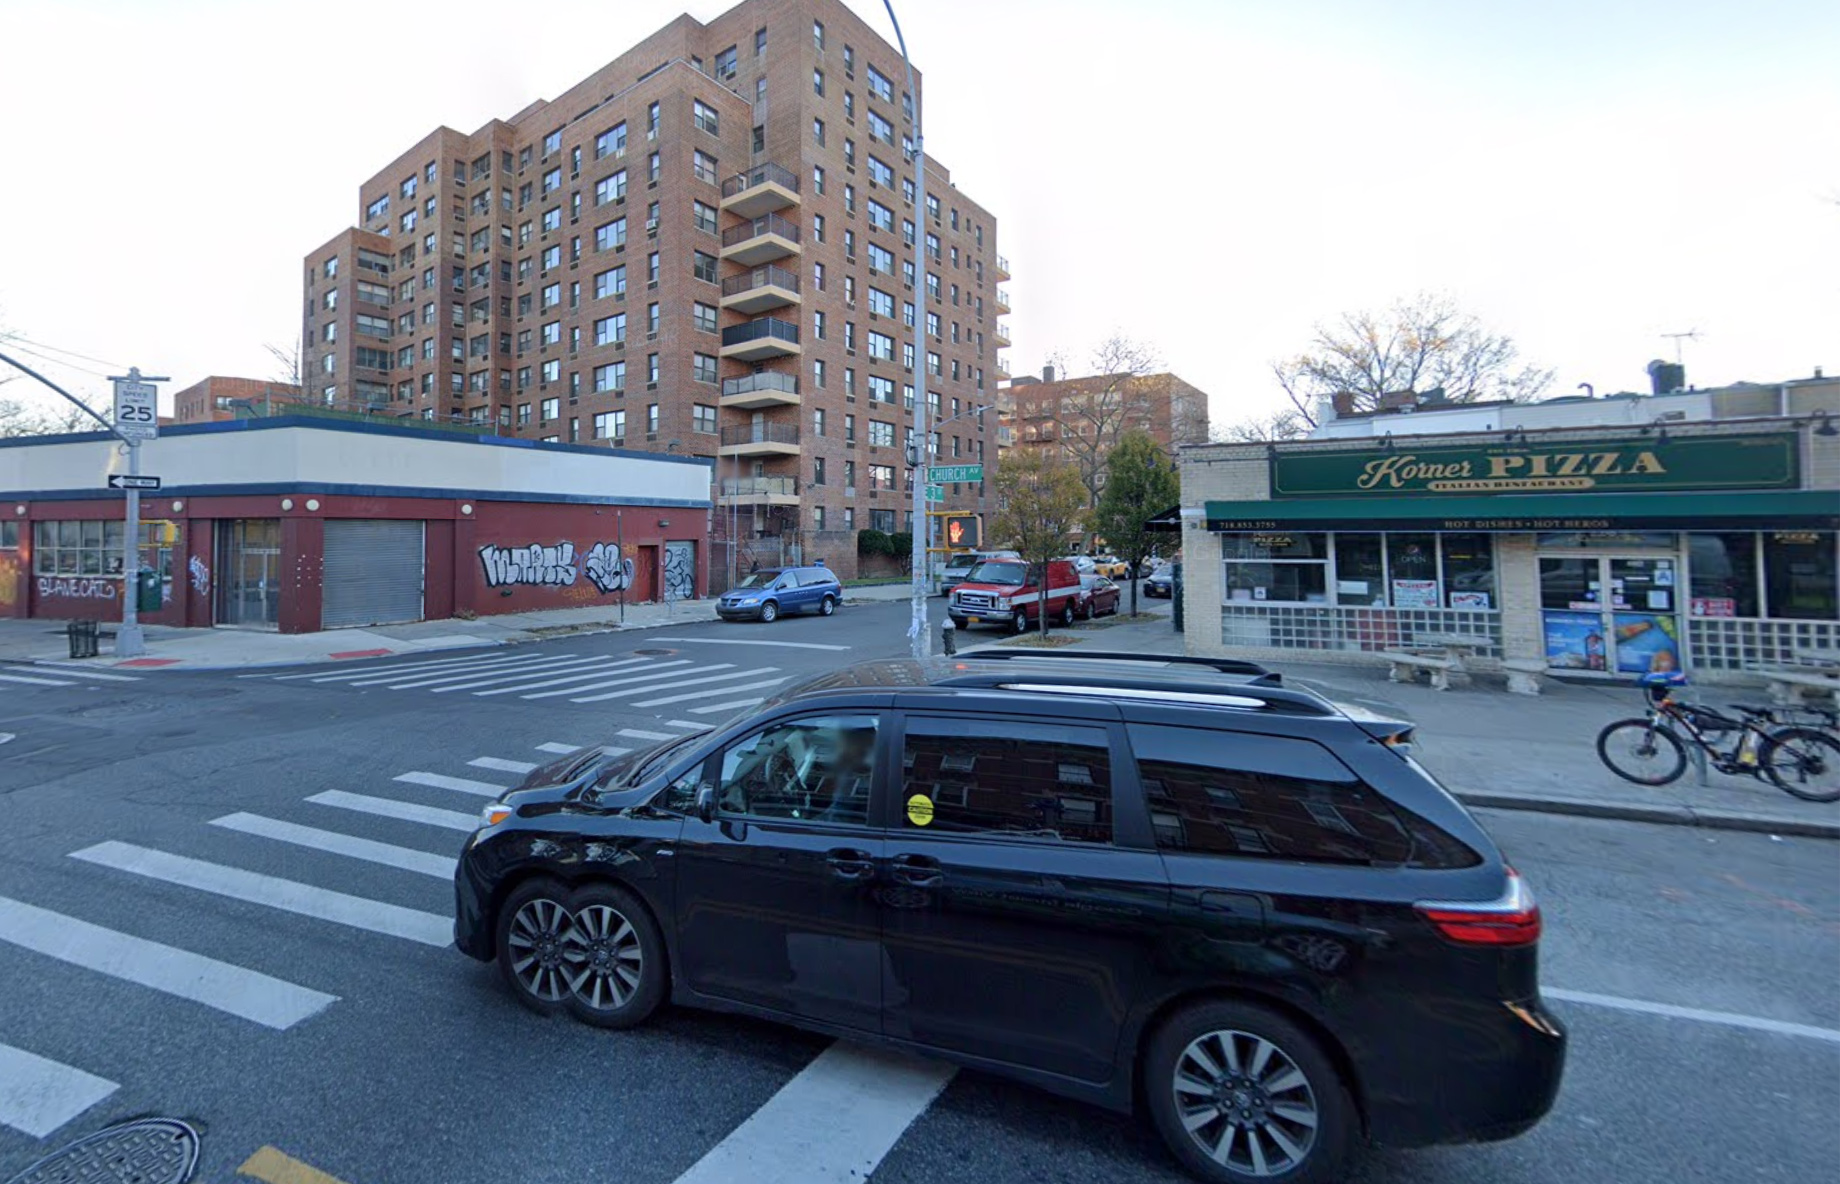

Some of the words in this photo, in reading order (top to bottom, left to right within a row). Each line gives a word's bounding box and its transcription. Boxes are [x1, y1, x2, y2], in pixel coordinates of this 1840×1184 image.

[120, 404, 152, 421] 25
[930, 468, 967, 480] CHURCH
[1357, 455, 1473, 488] Korner
[1487, 451, 1667, 478] PIZZA
[1433, 481, 1489, 489] ITALIAN
[1494, 479, 1585, 488] RESTAURANT
[1444, 520, 1470, 529] HOT
[1475, 520, 1523, 528] DISHES
[1534, 520, 1561, 528] HOT
[1564, 520, 1609, 528] HEROS
[1401, 555, 1427, 563] OPEN
